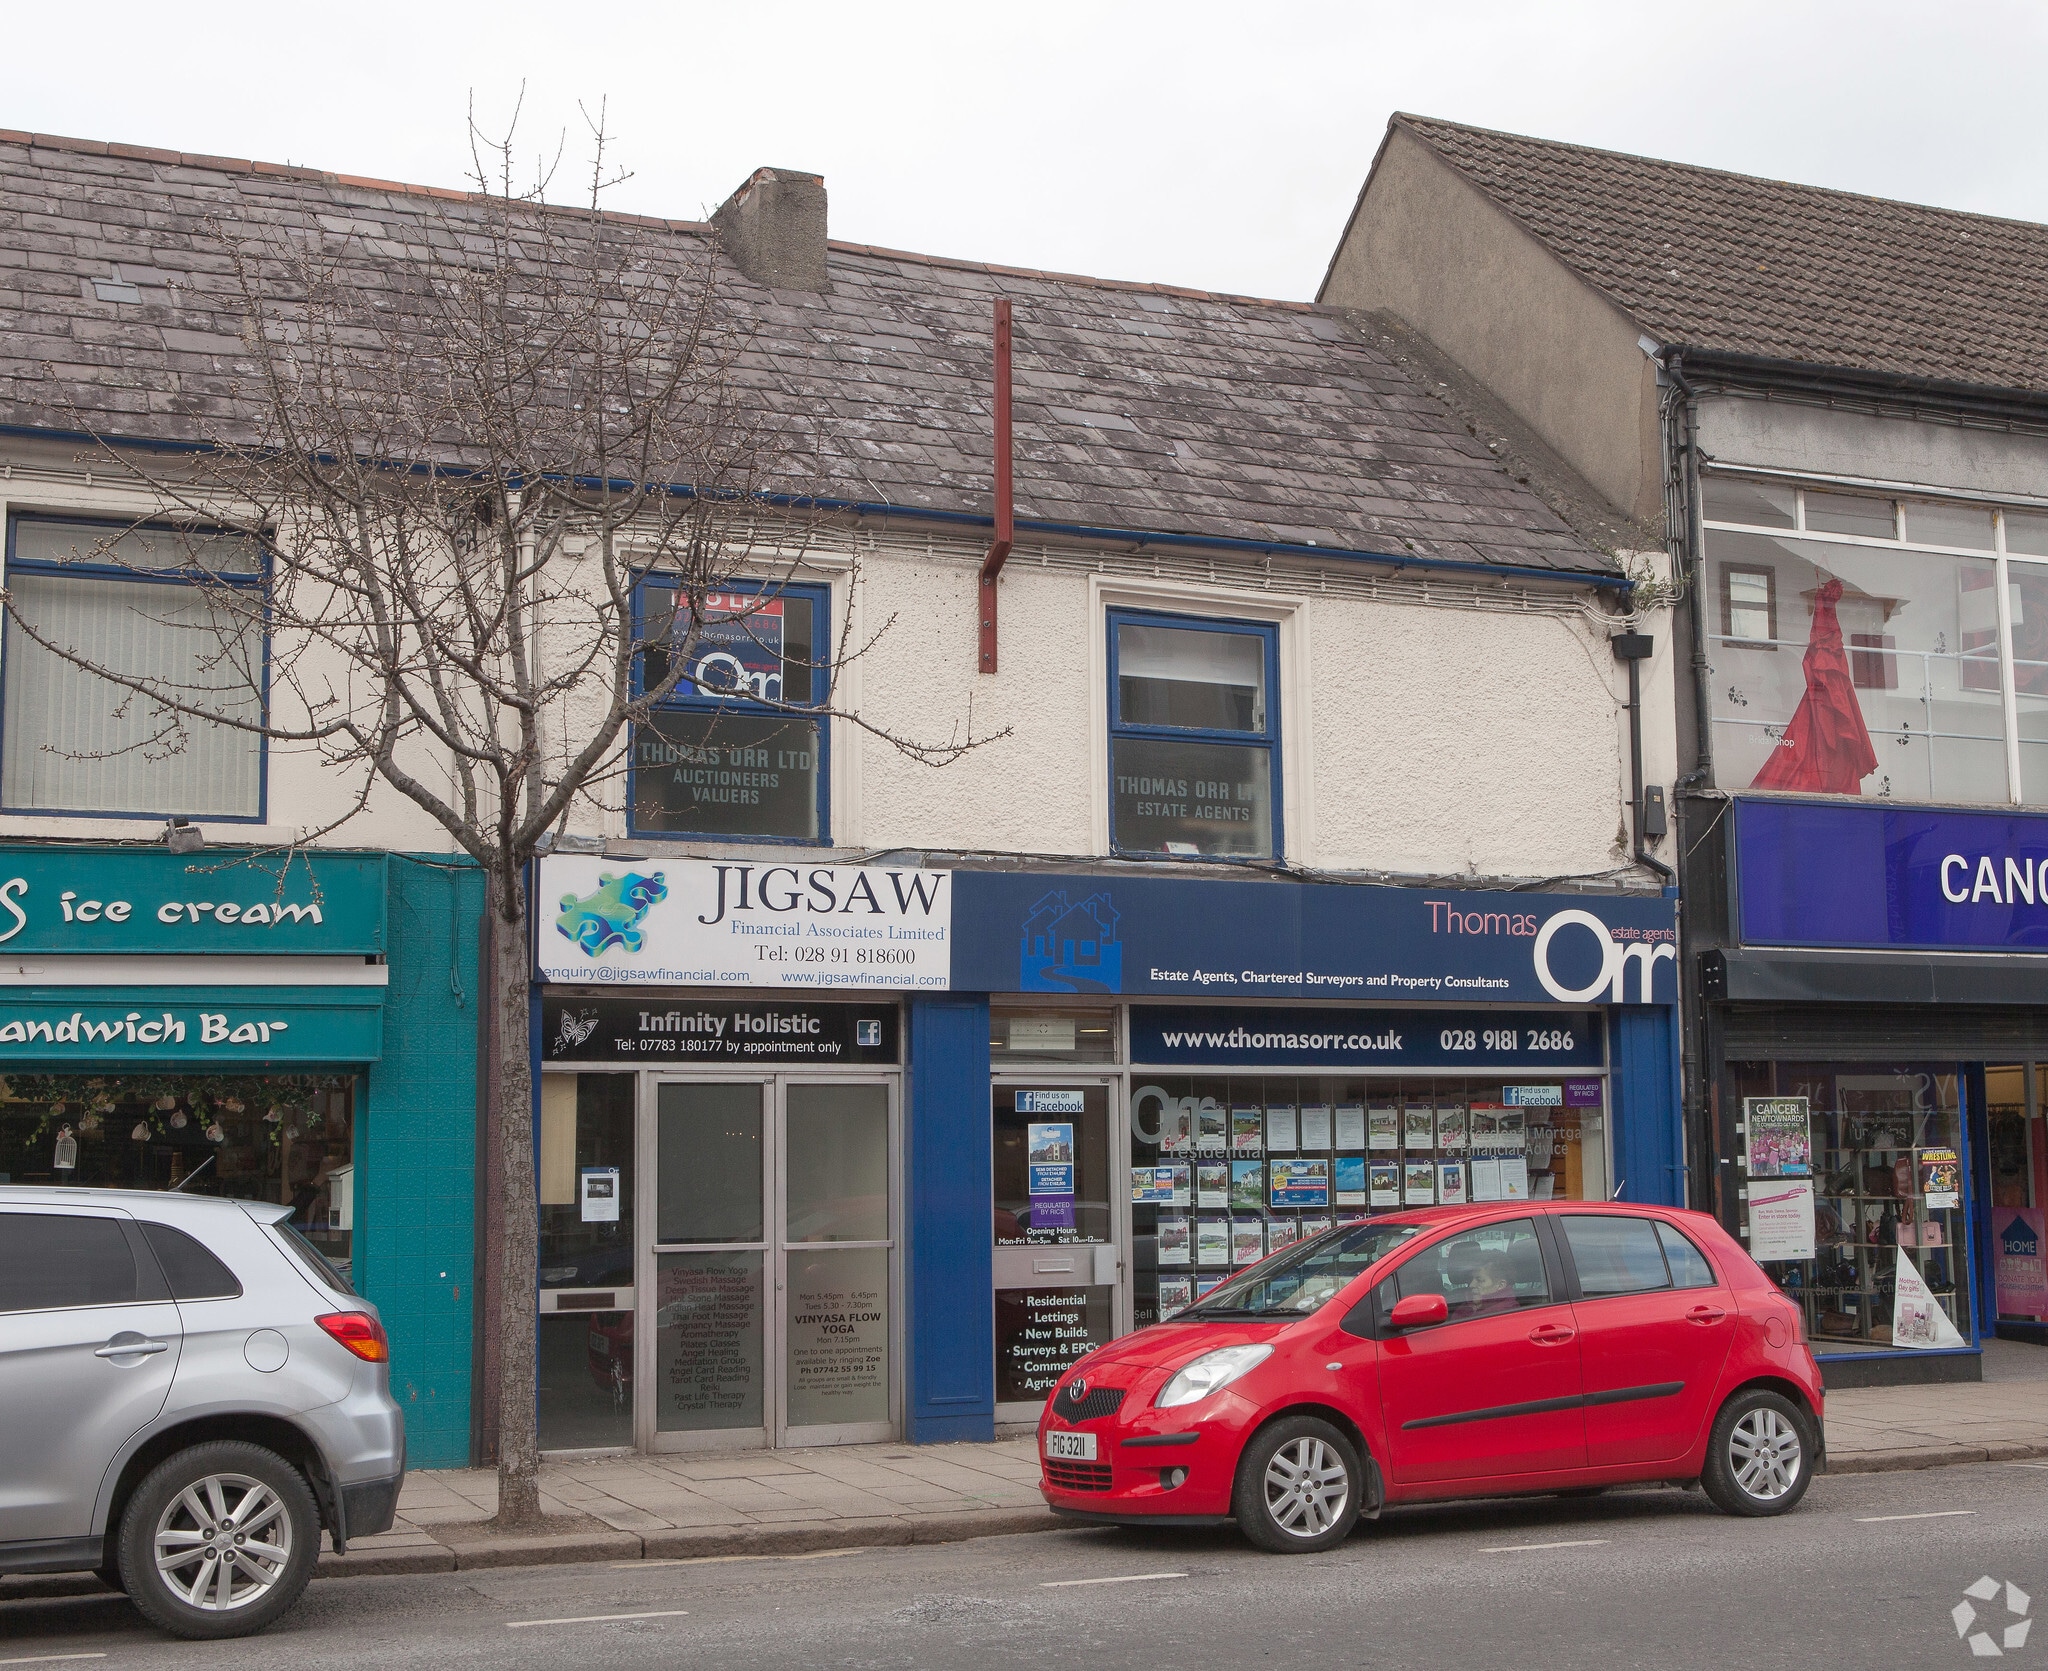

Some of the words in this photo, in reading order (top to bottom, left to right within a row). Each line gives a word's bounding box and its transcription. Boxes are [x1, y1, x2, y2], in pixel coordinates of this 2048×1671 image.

[696, 652, 781, 699] Orr
[1775, 736, 1794, 748] Shop
[640, 743, 720, 765] THOMAS
[730, 748, 768, 768] ORR
[778, 751, 810, 770] LTD
[673, 769, 779, 788] AUCTIONEERS
[1117, 776, 1188, 797] THOMAS
[1195, 781, 1229, 799] ORR
[692, 787, 759, 804] VALUERS
[1137, 802, 1186, 817] ESTATE
[1195, 806, 1249, 820] AGENTS
[698, 865, 946, 925] JIGSAW
[60, 891, 132, 922] ice
[157, 902, 322, 924] cream
[1424, 901, 1537, 937] Thomas
[731, 920, 800, 935] Financial
[806, 923, 883, 939] Associates
[888, 926, 945, 940] Limited
[1611, 927, 1640, 939] estate
[1642, 928, 1675, 943] agents
[754, 945, 788, 962] Tel:
[795, 947, 825, 962] 028
[831, 948, 848, 963] 91
[856, 949, 915, 964] 818600
[1533, 909, 1676, 1003] Orr
[544, 966, 749, 981] enquiry@jigsawfinancial.com
[782, 972, 946, 985] www.jigsawfinancial.com
[1151, 968, 1189, 980] Estate
[1192, 970, 1238, 985] Agents,
[1241, 971, 1302, 984] Chartered
[1306, 972, 1363, 987] Surveyors
[1367, 975, 1387, 986] and
[1391, 975, 1441, 990] Property
[1445, 976, 1509, 988] Consultants
[200, 1013, 288, 1043] Bar
[639, 1011, 727, 1037] Infinity
[734, 1013, 819, 1034] Holistic
[1162, 1028, 1403, 1050] www.thomasorr.co.uk
[1440, 1030, 1476, 1050] 028
[1483, 1030, 1518, 1050] 9181
[1527, 1030, 1574, 1050] 2686
[615, 1039, 635, 1050] Tel:
[640, 1040, 675, 1051] 07783
[680, 1040, 722, 1051] 180177
[727, 1041, 740, 1054] by
[744, 1042, 814, 1054] appointment
[818, 1042, 841, 1054] only
[1035, 1102, 1083, 1111] Facebook
[1520, 1095, 1561, 1105] Facebook
[1132, 1086, 1215, 1144] Orr
[1757, 1104, 1799, 1114] CANCER!
[1535, 1127, 1582, 1140] Mortga
[1170, 1145, 1265, 1159] residential
[1446, 1146, 1455, 1156] &
[1461, 1145, 1520, 1156] Financial
[1525, 1143, 1568, 1155] Advice
[1922, 1152, 1957, 1160] WRESTLING
[1027, 1228, 1055, 1236] Opening
[2005, 1240, 2035, 1253] HOME
[728, 1267, 748, 1275] Yoga
[674, 1277, 707, 1285] Swedish
[711, 1276, 746, 1285] Massage
[1027, 1295, 1086, 1307] Residential
[713, 1312, 748, 1320] Massage
[795, 1315, 845, 1324] VINYASA
[849, 1313, 881, 1322] FLOW
[1035, 1312, 1079, 1324] Lettings
[1135, 1309, 1152, 1319] Sell
[681, 1330, 738, 1339] Aromatherapy
[822, 1325, 854, 1334] YOGA
[1026, 1329, 1052, 1339] New
[1056, 1327, 1088, 1338] Builds
[836, 1346, 882, 1355] appointments
[1013, 1346, 1057, 1358] Surveys
[1060, 1345, 1068, 1354] &
[675, 1358, 718, 1366] Meditation
[721, 1357, 746, 1366] Group
[1024, 1362, 1073, 1372] Commer
[670, 1368, 693, 1376] Angel
[718, 1366, 750, 1374] Reading
[717, 1375, 749, 1383] Reading
[678, 1402, 706, 1411] Crystal
[709, 1401, 742, 1409] Therapy
[1053, 1436, 1065, 1455] FIG
[1067, 1436, 1085, 1457] 3211
